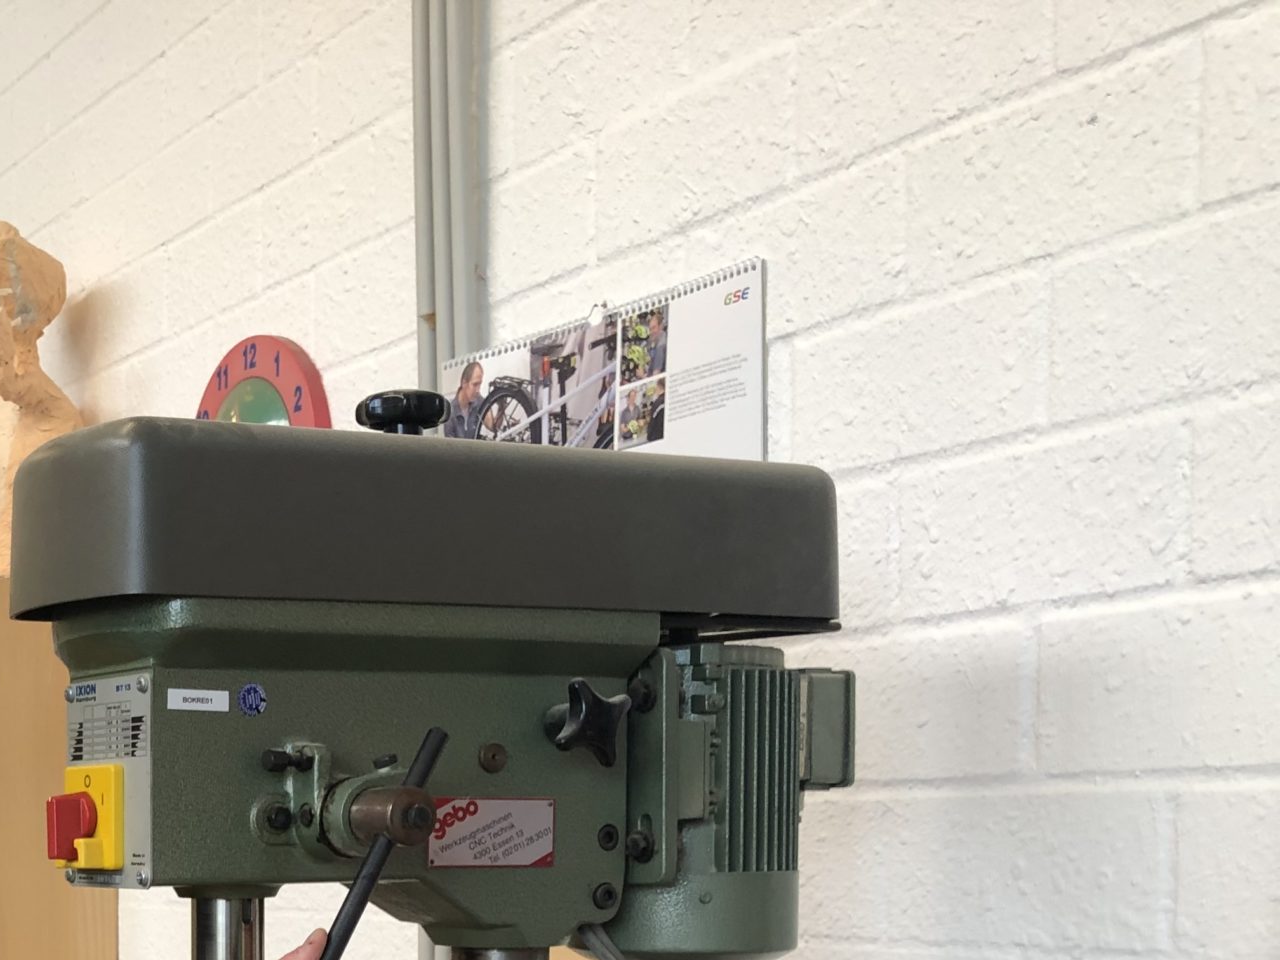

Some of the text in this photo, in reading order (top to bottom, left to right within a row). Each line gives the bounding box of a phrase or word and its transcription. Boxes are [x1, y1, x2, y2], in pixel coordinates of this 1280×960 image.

[723, 286, 751, 306] GSE
[242, 343, 257, 371] 12
[274, 351, 280, 378] 1
[216, 364, 229, 391] 11
[293, 385, 302, 413] 2
[75, 683, 96, 697] IXION
[468, 822, 515, 852] CNC Technik
[492, 836, 514, 852] Essen
